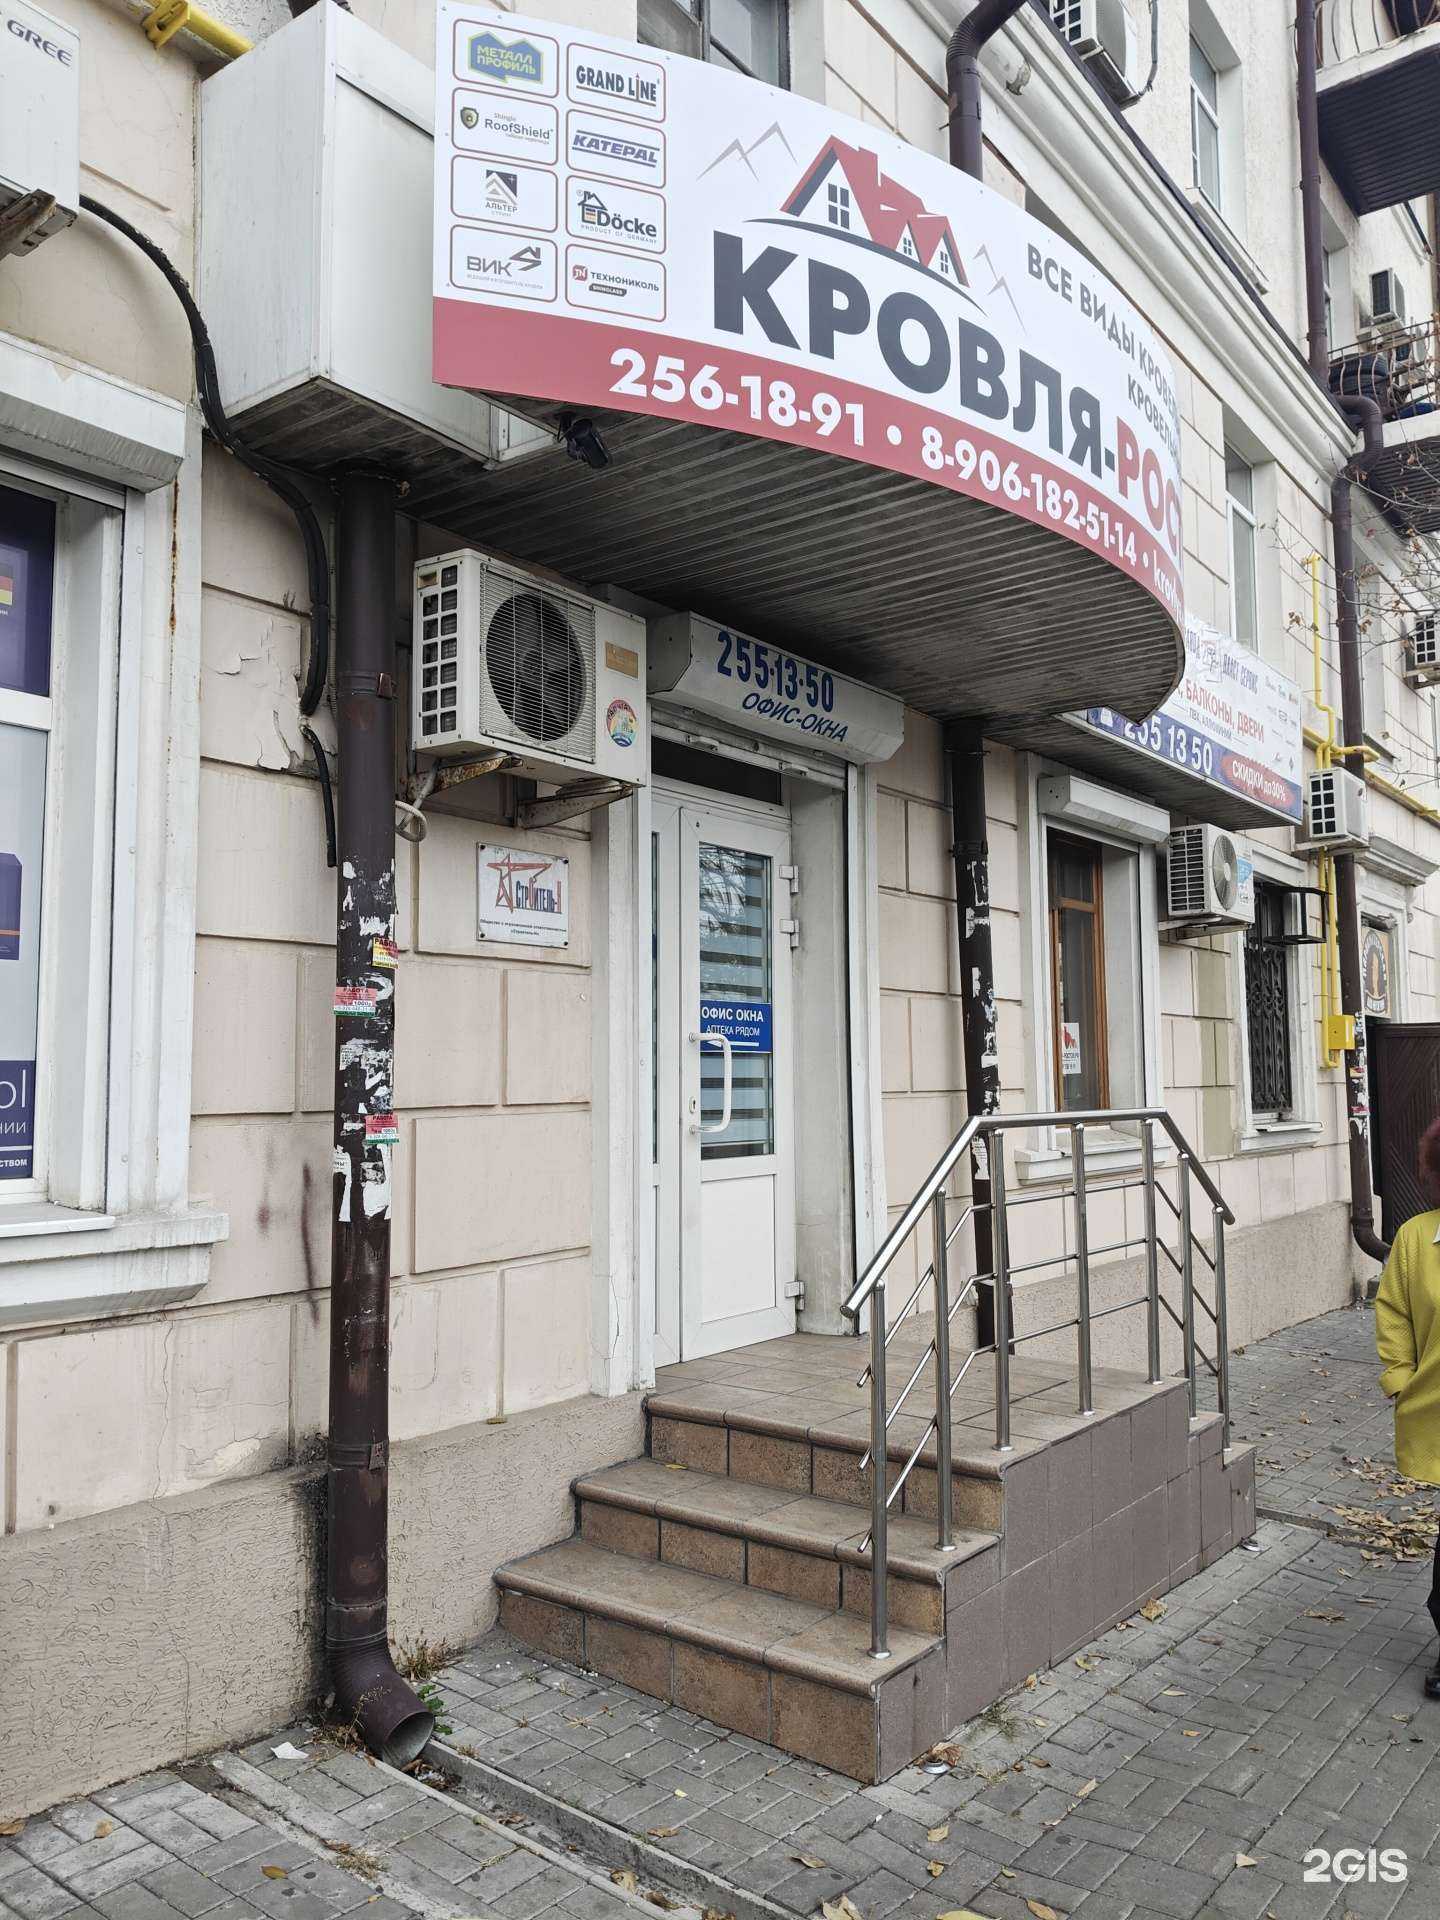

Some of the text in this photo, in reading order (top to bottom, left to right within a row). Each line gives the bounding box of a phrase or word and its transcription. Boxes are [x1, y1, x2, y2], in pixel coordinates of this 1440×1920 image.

[7, 19, 72, 67] GREE
[477, 45, 533, 65] МЕТАЛЛ
[477, 56, 536, 75] ПРОФИЛЬ
[576, 65, 625, 93] GRAND
[484, 118, 550, 140] RoofShield
[573, 135, 658, 163] KATEPAL
[485, 202, 518, 213] АЛЬТЕР
[597, 209, 657, 238] Döcke
[467, 255, 512, 277] ВИК
[590, 271, 660, 292] ТЕХНОНИКОЛЬ
[1027, 243, 1073, 303] ВСЕ
[1080, 281, 1135, 361] ВИДЫ
[609, 348, 864, 447] 256-18-91
[921, 426, 1137, 567] 8-906-182-51-14
[742, 692, 848, 742] ОФИС-ОКНА
[1237, 709, 1264, 743] ДВЕРИ
[1168, 725, 1187, 763] 13
[1192, 736, 1213, 776] 50
[1232, 760, 1264, 789] СКИДКИ
[702, 1007, 763, 1022] ОФИС ОКНА
[706, 1025, 760, 1037] АПТЕКА РЯДОМ
